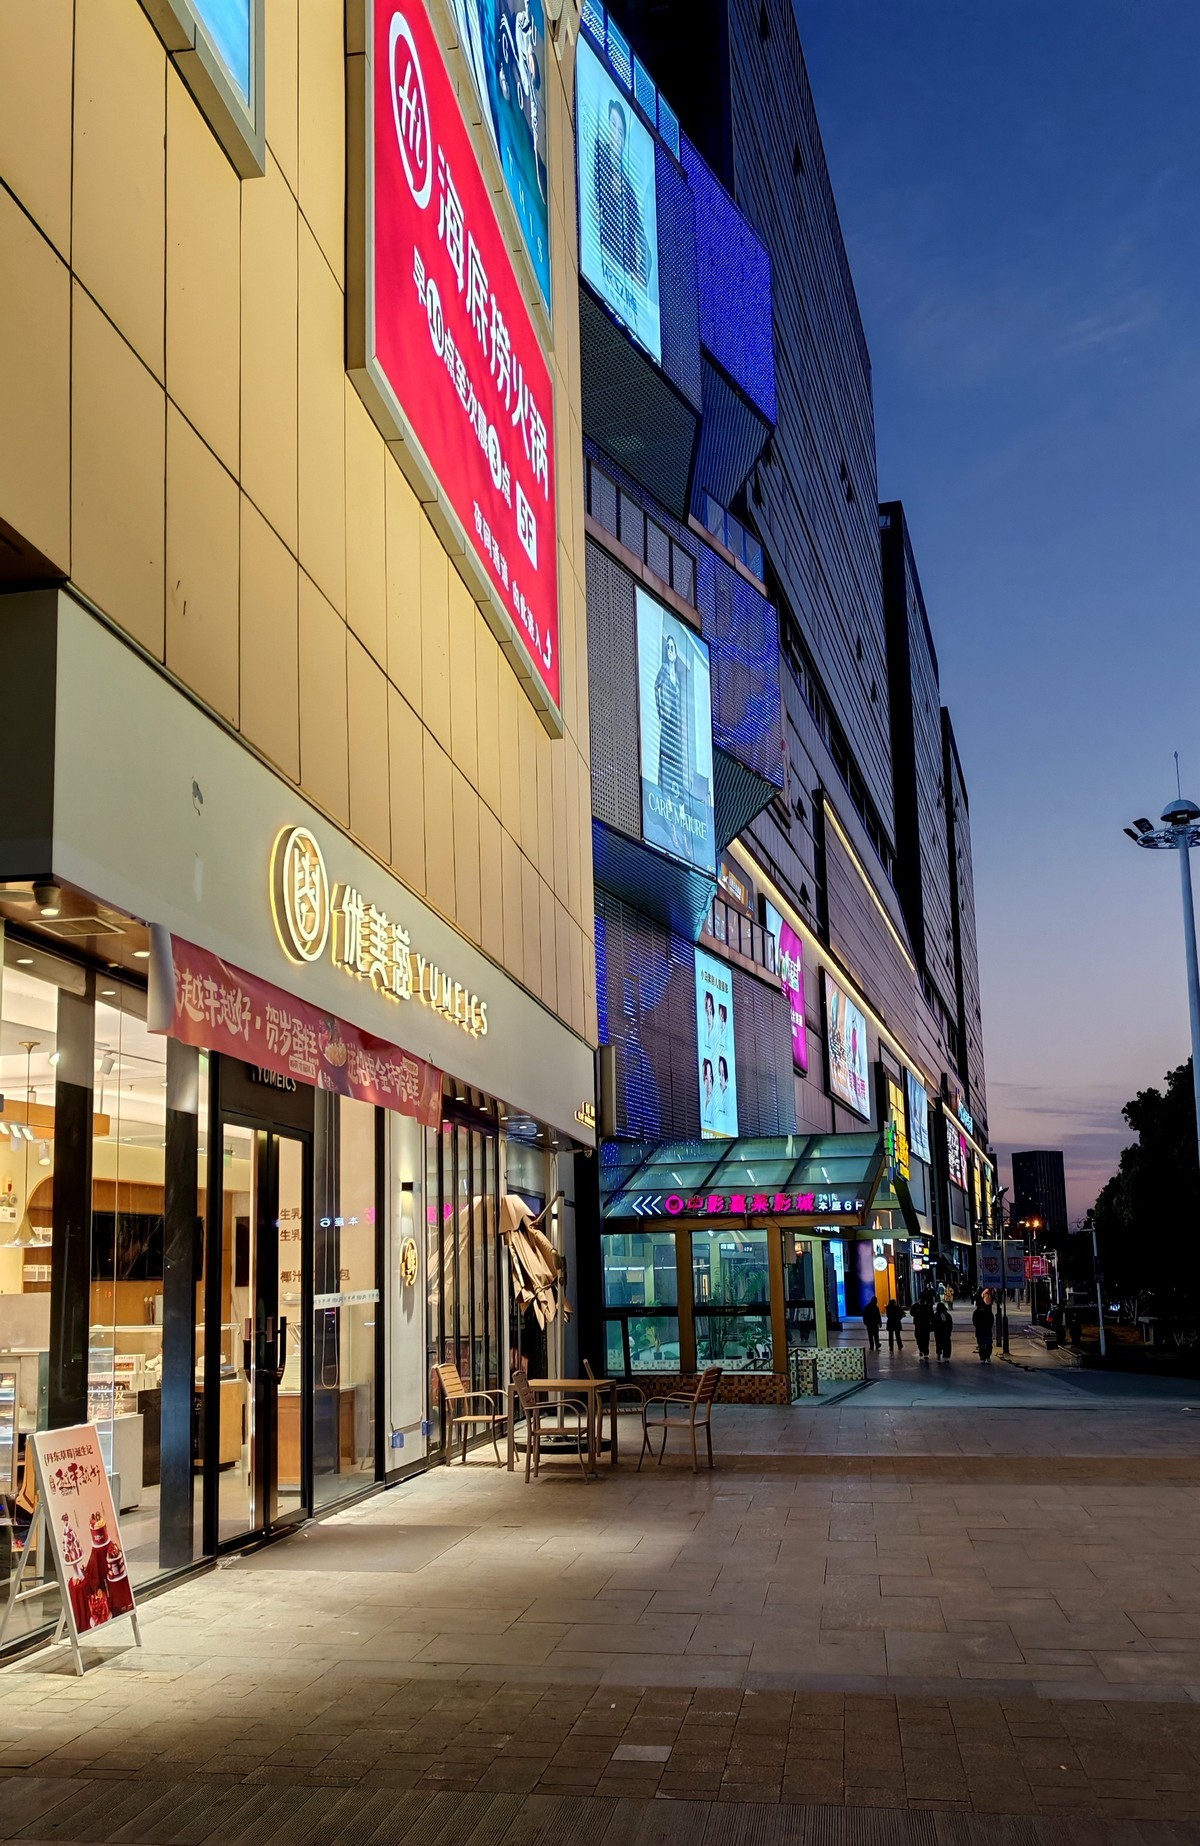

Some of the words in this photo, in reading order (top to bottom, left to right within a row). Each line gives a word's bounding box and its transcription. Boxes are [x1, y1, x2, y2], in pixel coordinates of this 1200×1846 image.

[398, 60, 424, 169] Hi
[437, 144, 549, 502] 海底捞火锅
[520, 494, 534, 550] 5F
[473, 500, 510, 592] 夜间通道
[511, 579, 543, 657] 由此进入
[648, 792, 674, 823] CARE
[411, 951, 488, 1038] YUMEICS
[258, 1066, 297, 1092] YUMEICS
